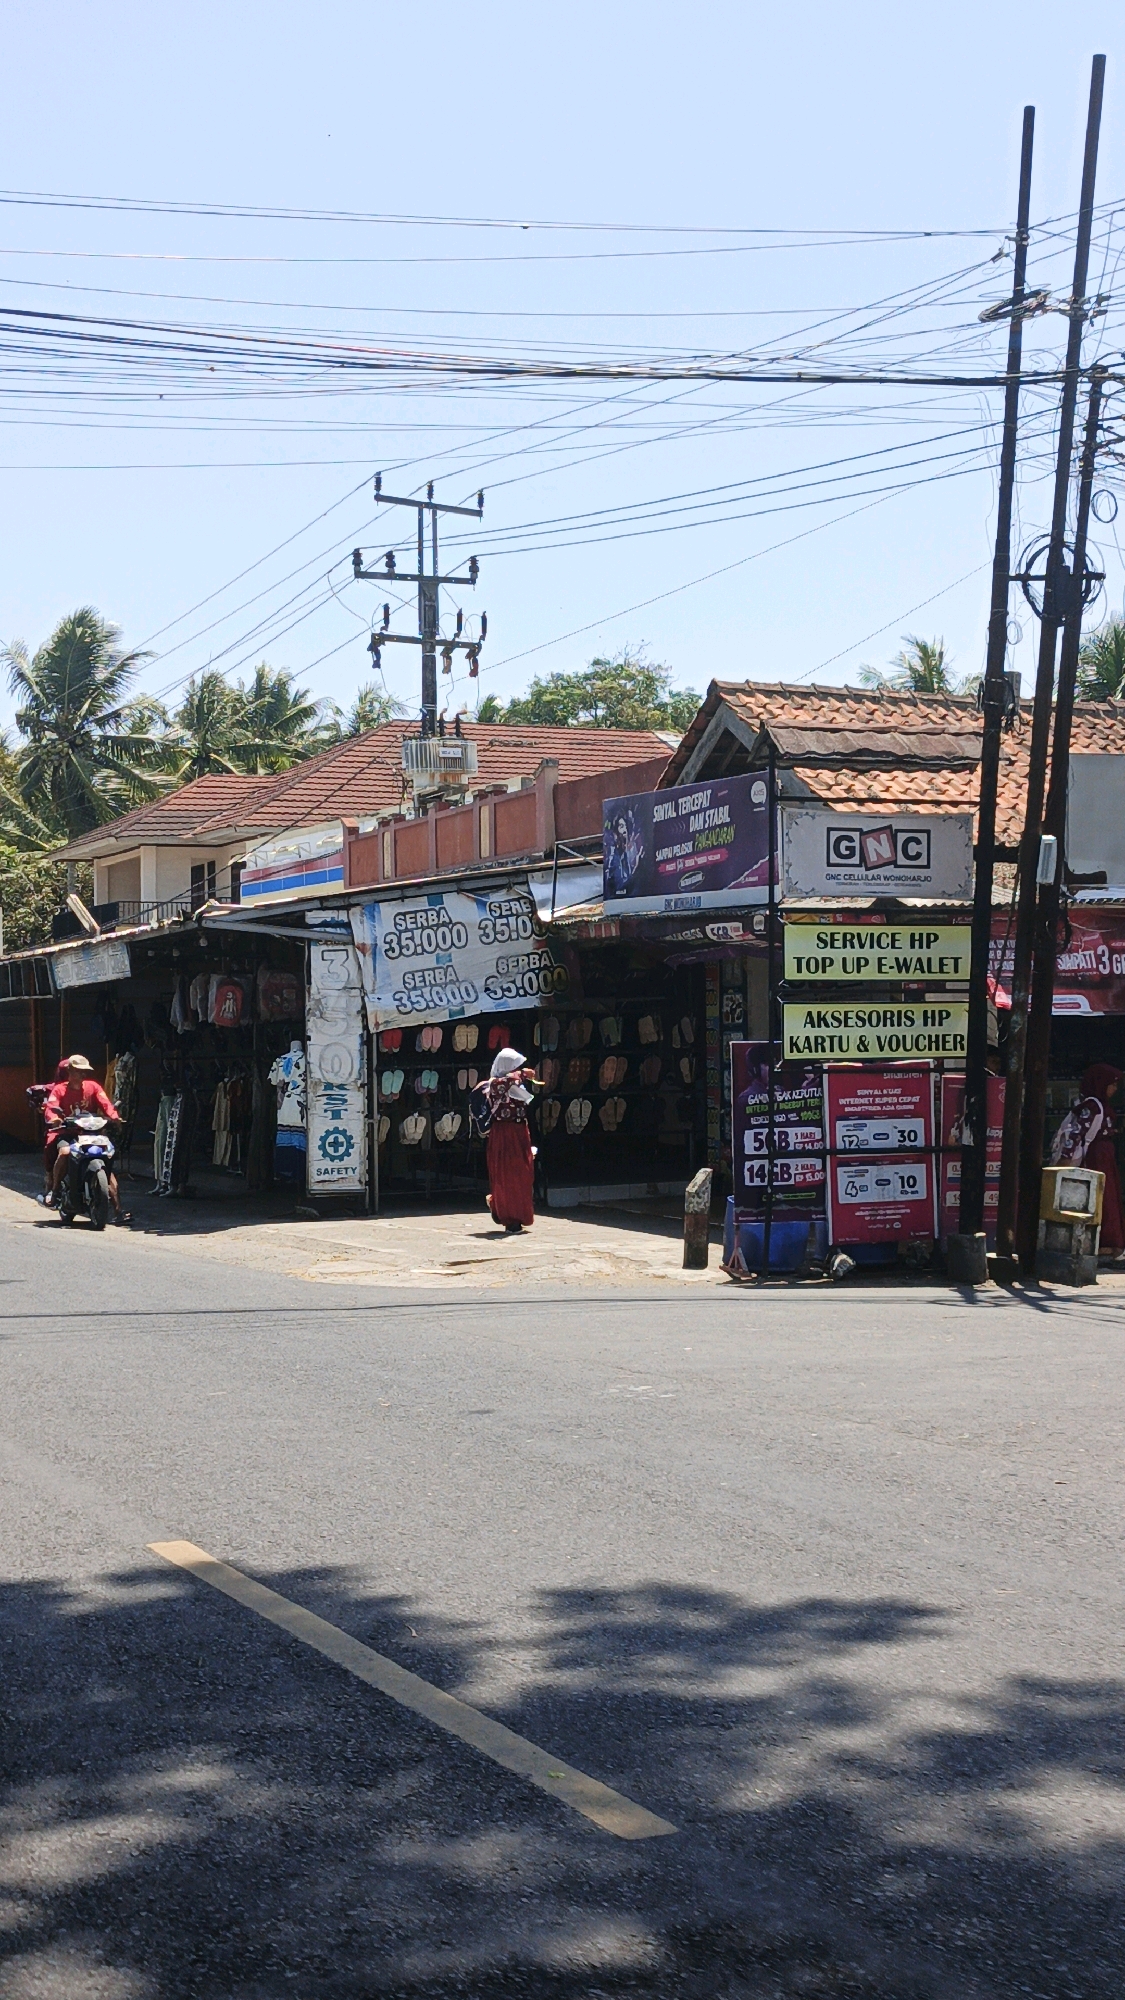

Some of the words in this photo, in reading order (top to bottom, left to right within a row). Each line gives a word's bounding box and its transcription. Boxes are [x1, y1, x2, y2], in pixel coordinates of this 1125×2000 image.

[678, 789, 712, 816] TERCEPAT
[705, 805, 731, 826] STABIL
[832, 832, 923, 863] GNC
[825, 873, 842, 881] GNC
[843, 873, 881, 881] CELLULAR
[394, 907, 452, 930] SERBA
[816, 932, 902, 949] SERVICE
[910, 932, 939, 949] HP
[496, 949, 554, 974] SERBA
[793, 956, 834, 974] TOP
[842, 956, 869, 974] UP
[877, 956, 962, 974] E-WALET
[1097, 945, 1110, 975] 3
[403, 965, 459, 989] SERBA
[803, 1010, 914, 1028] AKSESORIS
[922, 1010, 951, 1027] HP
[789, 1035, 850, 1053] KARTU
[856, 1035, 869, 1052] &
[876, 1034, 965, 1052] VOUCHER
[897, 1130, 918, 1143] 30
[316, 1166, 358, 1176] SAFETY
[899, 1175, 917, 1189] 10
